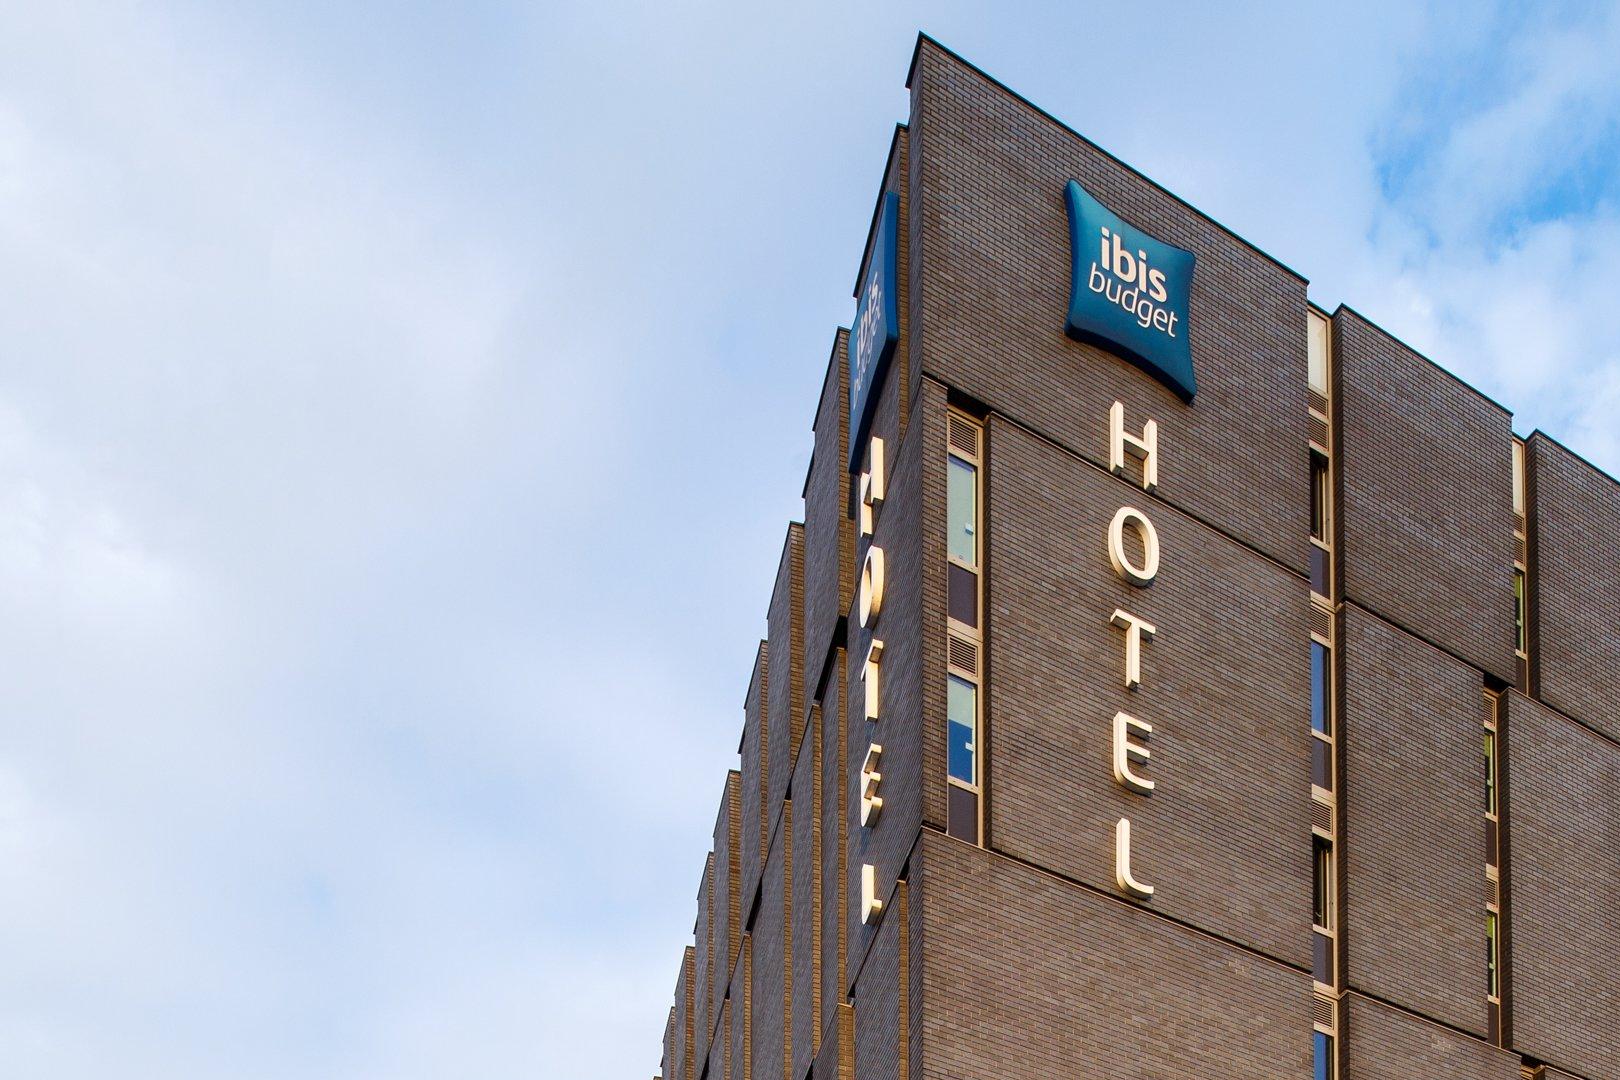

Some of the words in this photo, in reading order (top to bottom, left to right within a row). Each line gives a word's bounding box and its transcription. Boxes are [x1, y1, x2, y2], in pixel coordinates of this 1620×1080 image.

[1088, 261, 1179, 337] budget
[1101, 226, 1167, 303] ibis
[859, 435, 885, 927] HOTEL
[1108, 401, 1160, 900] HOTEL
